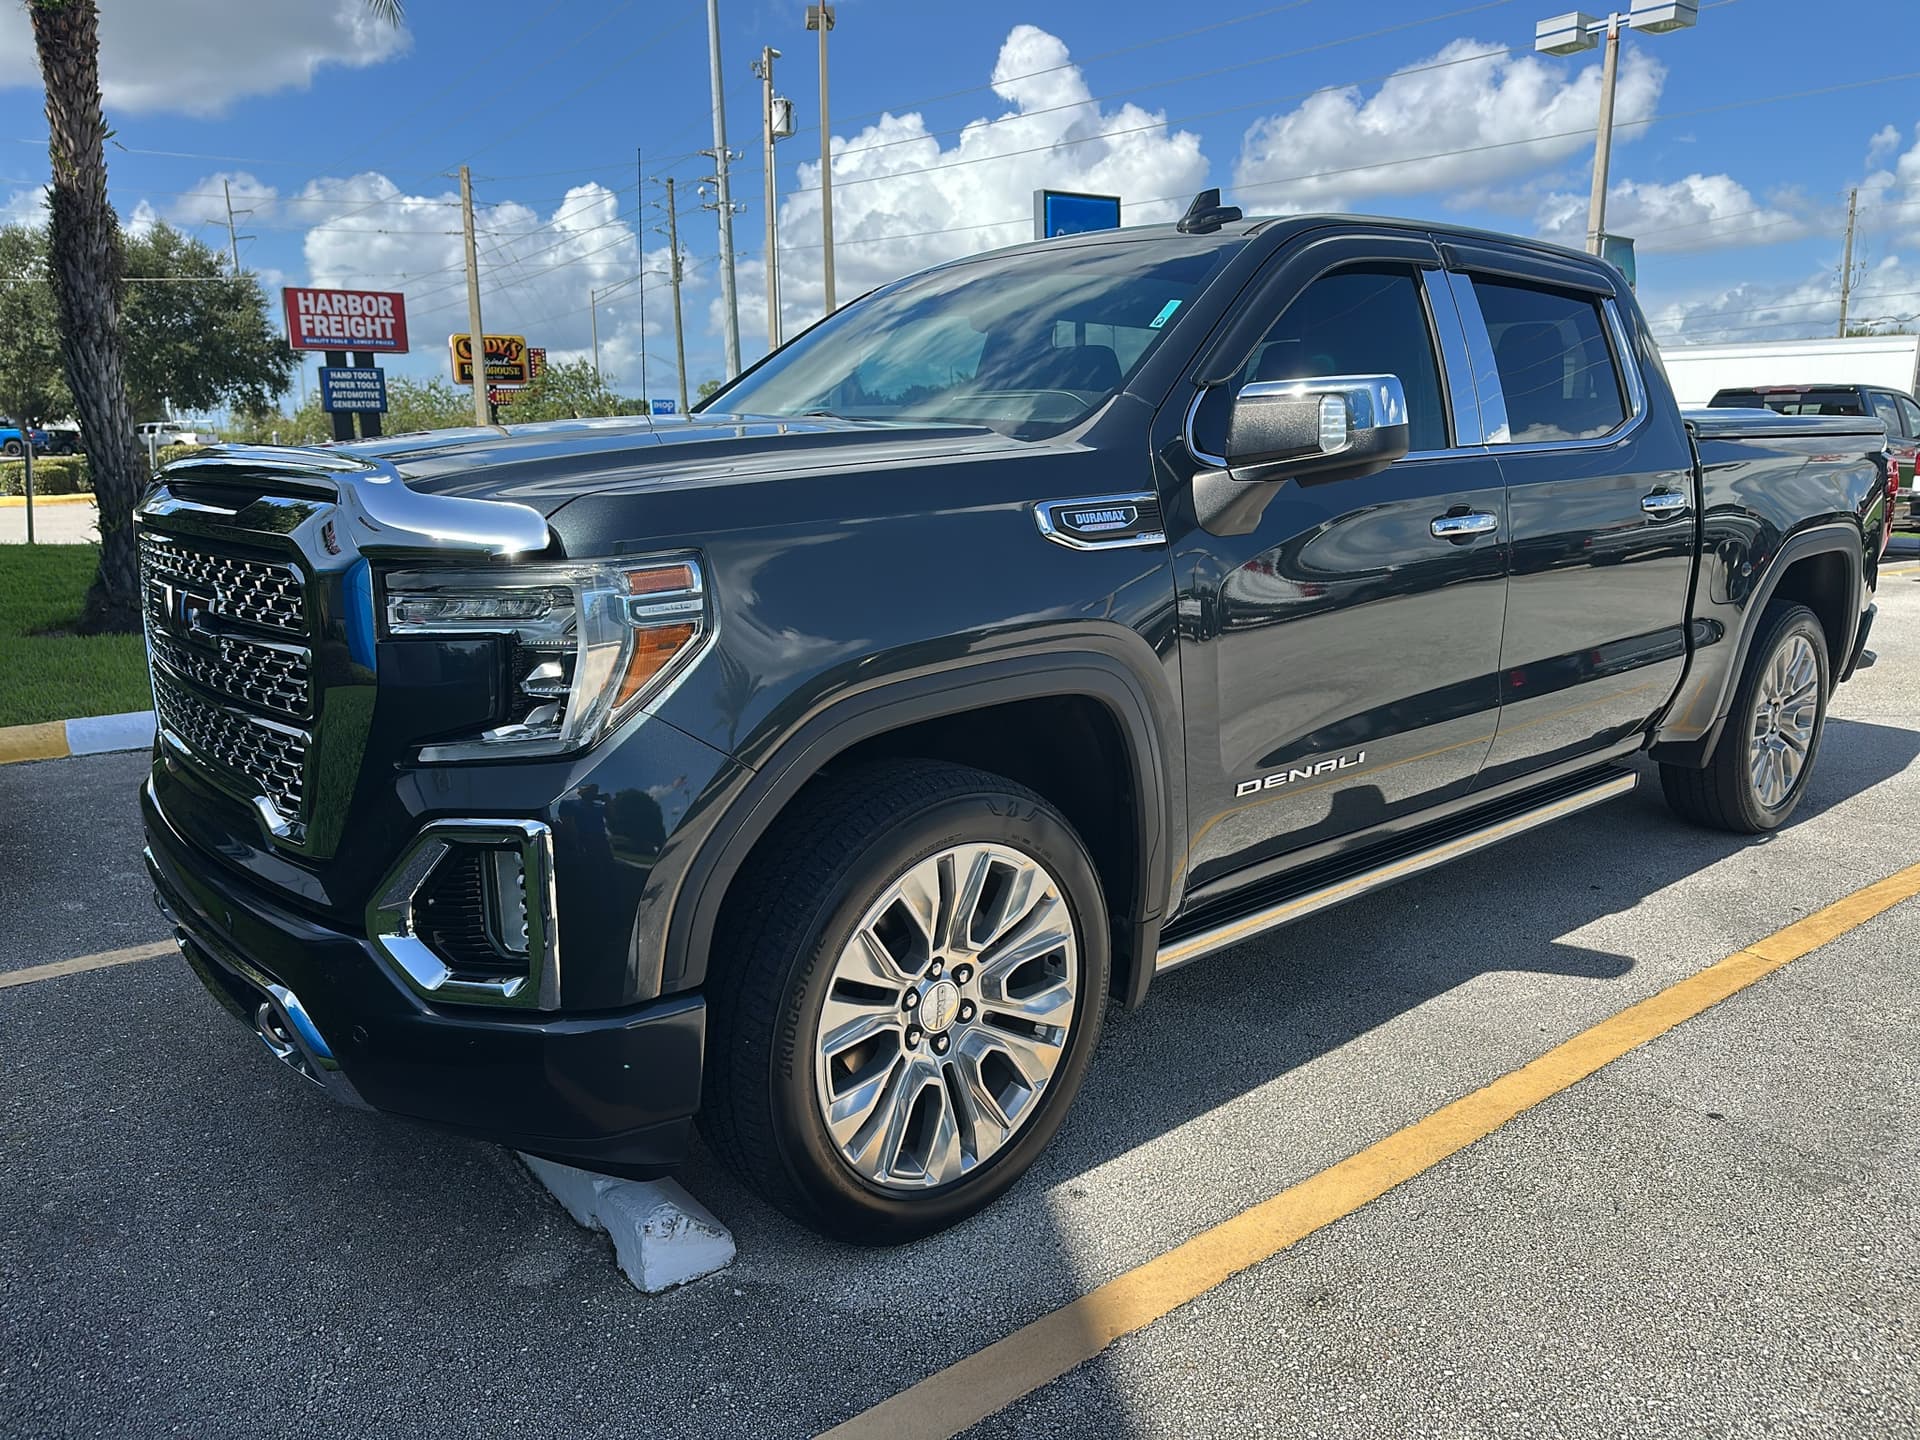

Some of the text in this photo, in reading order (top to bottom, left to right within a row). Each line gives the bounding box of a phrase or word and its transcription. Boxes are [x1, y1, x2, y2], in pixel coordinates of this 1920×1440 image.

[297, 292, 394, 317] HARBOR
[300, 315, 396, 338] FREIGHT
[457, 338, 523, 360] CDY'S
[330, 371, 377, 380] HAND TOOLS
[329, 381, 380, 390] POWER TOOLS
[332, 391, 380, 399] AUTOMOTIVE
[333, 400, 381, 409] GENERATORS
[1075, 510, 1126, 525] DURAMAX
[1235, 751, 1366, 798] DENALI
[779, 936, 828, 1081] BRIDGESTONE
